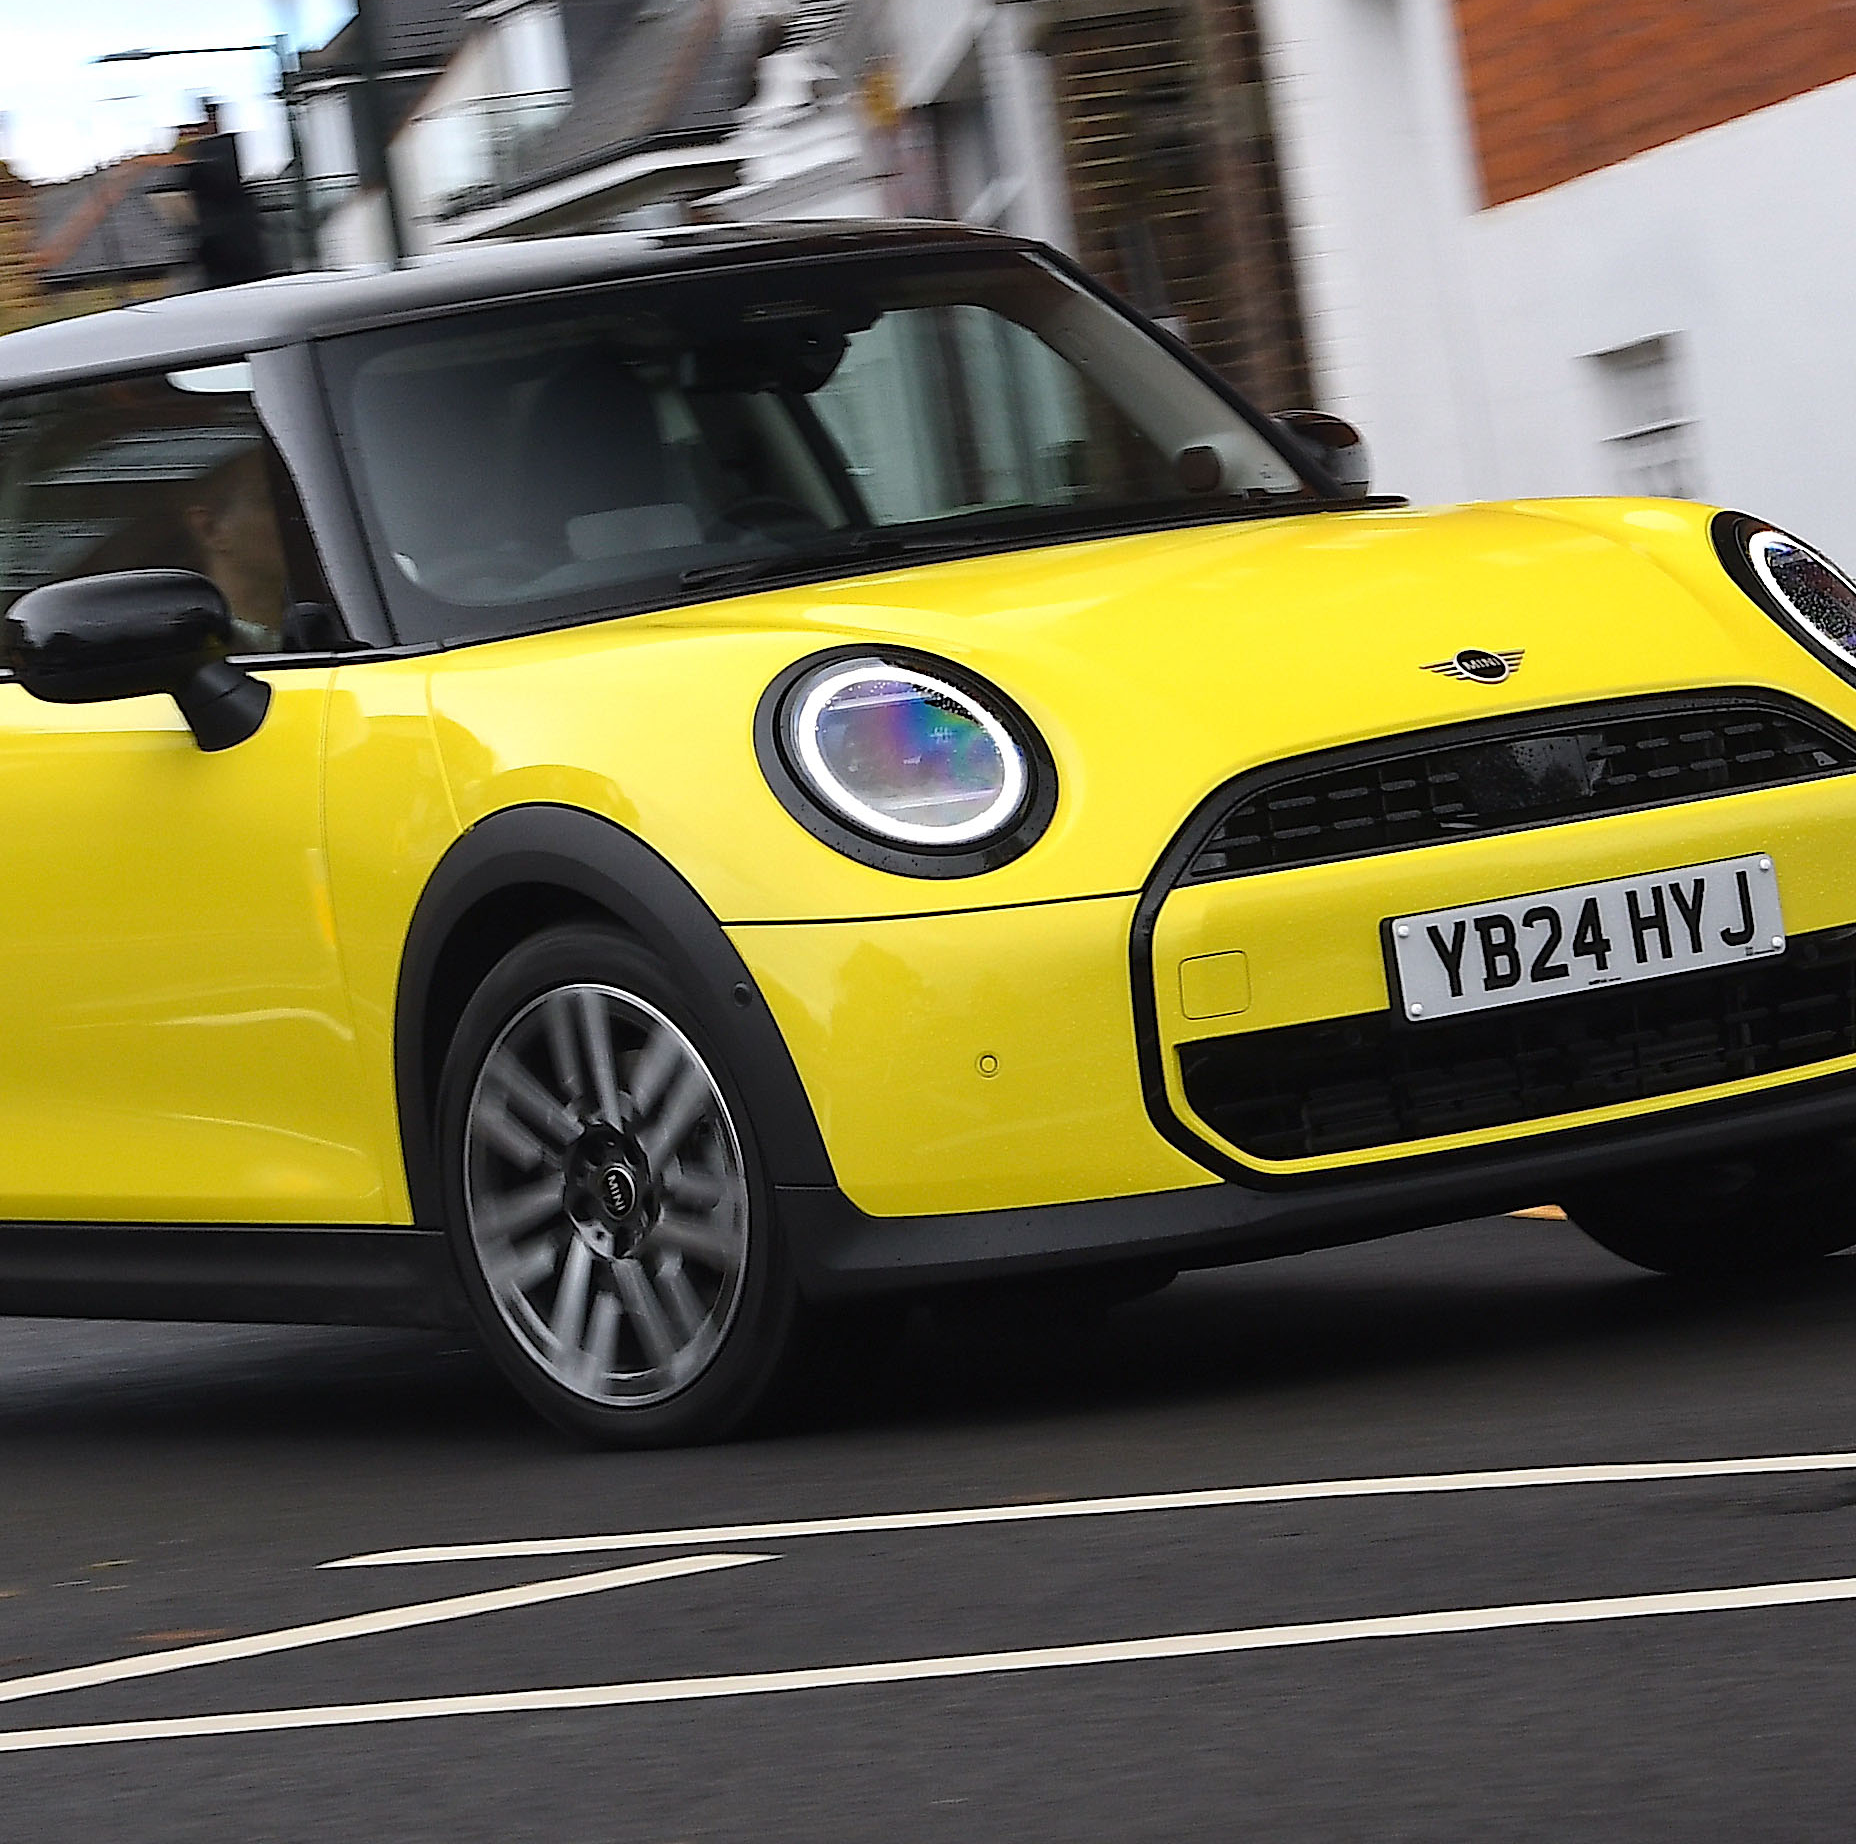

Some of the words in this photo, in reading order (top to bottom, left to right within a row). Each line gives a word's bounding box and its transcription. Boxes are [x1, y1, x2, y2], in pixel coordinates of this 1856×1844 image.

[1461, 657, 1501, 670] MINI
[1426, 898, 1612, 997] YB24
[1626, 871, 1756, 963] HYJ
[608, 1174, 626, 1210] MINI
